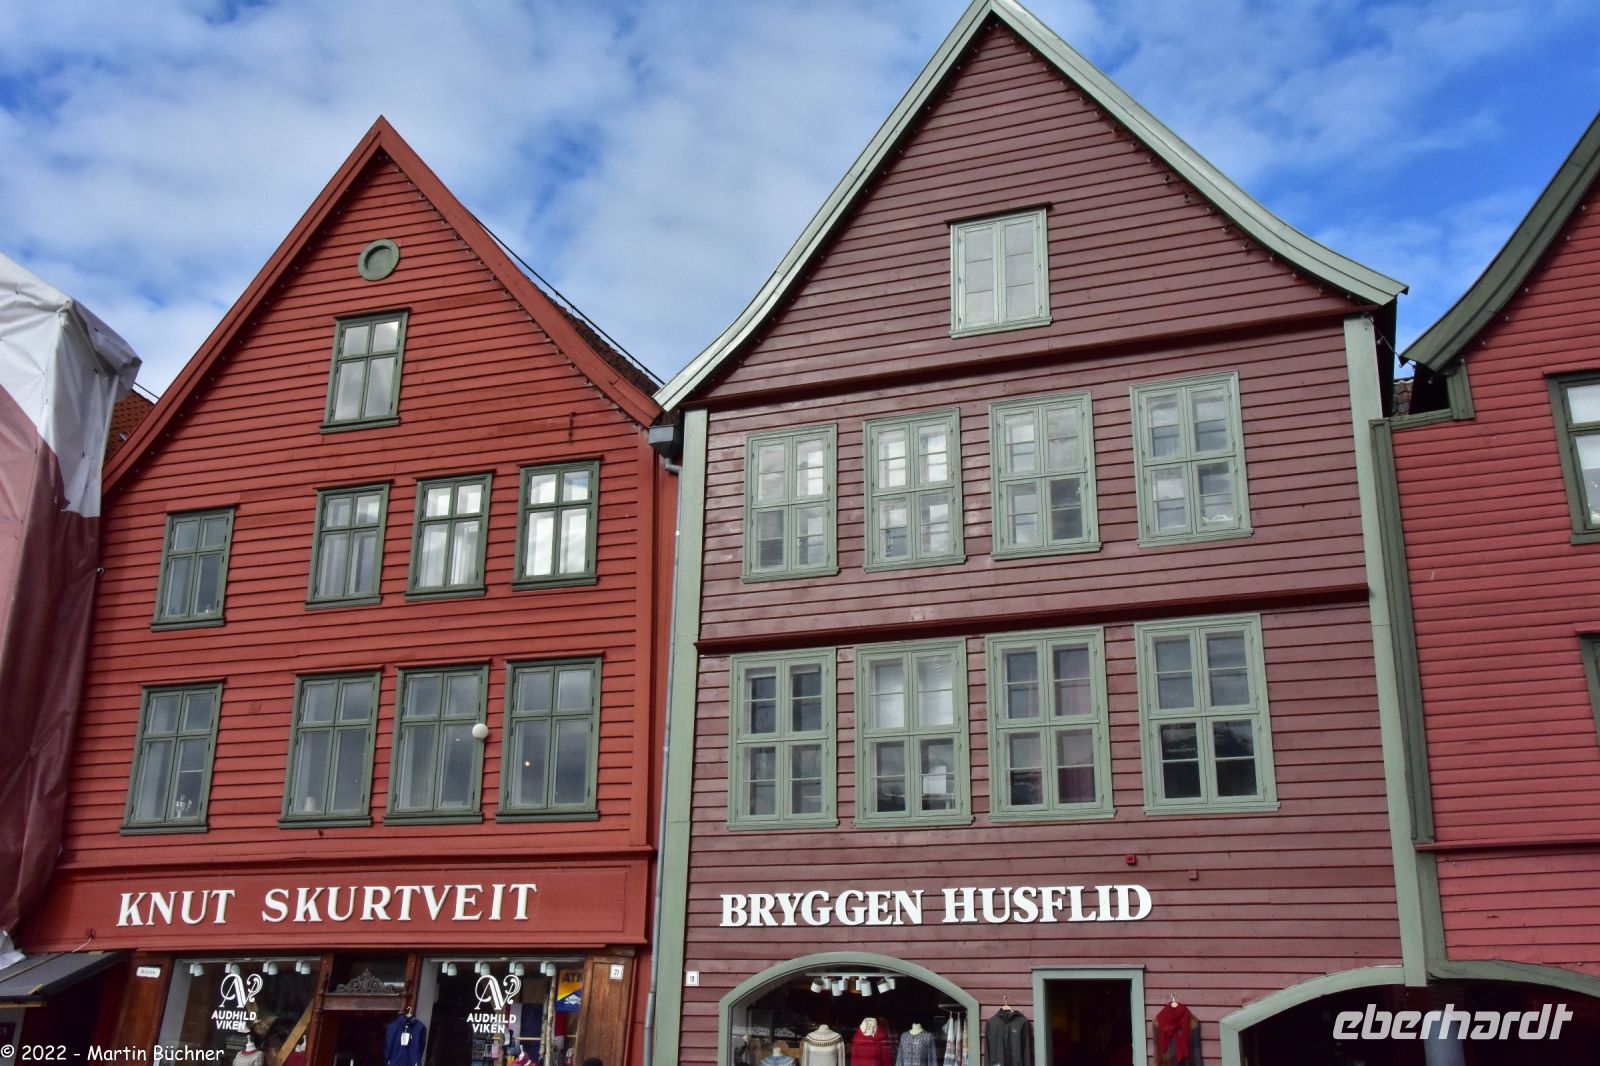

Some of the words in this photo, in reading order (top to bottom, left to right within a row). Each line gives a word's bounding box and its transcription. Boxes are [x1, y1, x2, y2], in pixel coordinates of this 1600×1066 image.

[115, 889, 236, 928] KNUT
[261, 883, 538, 923] SKURTVEIT
[719, 889, 925, 928] BRYGGEN
[941, 884, 1153, 925] HUSFLID
[211, 1010, 257, 1021] AUDHILD
[466, 1013, 517, 1024] AUDHILD
[216, 1021, 247, 1031] VIKEN
[472, 1023, 506, 1034] VIKEN
